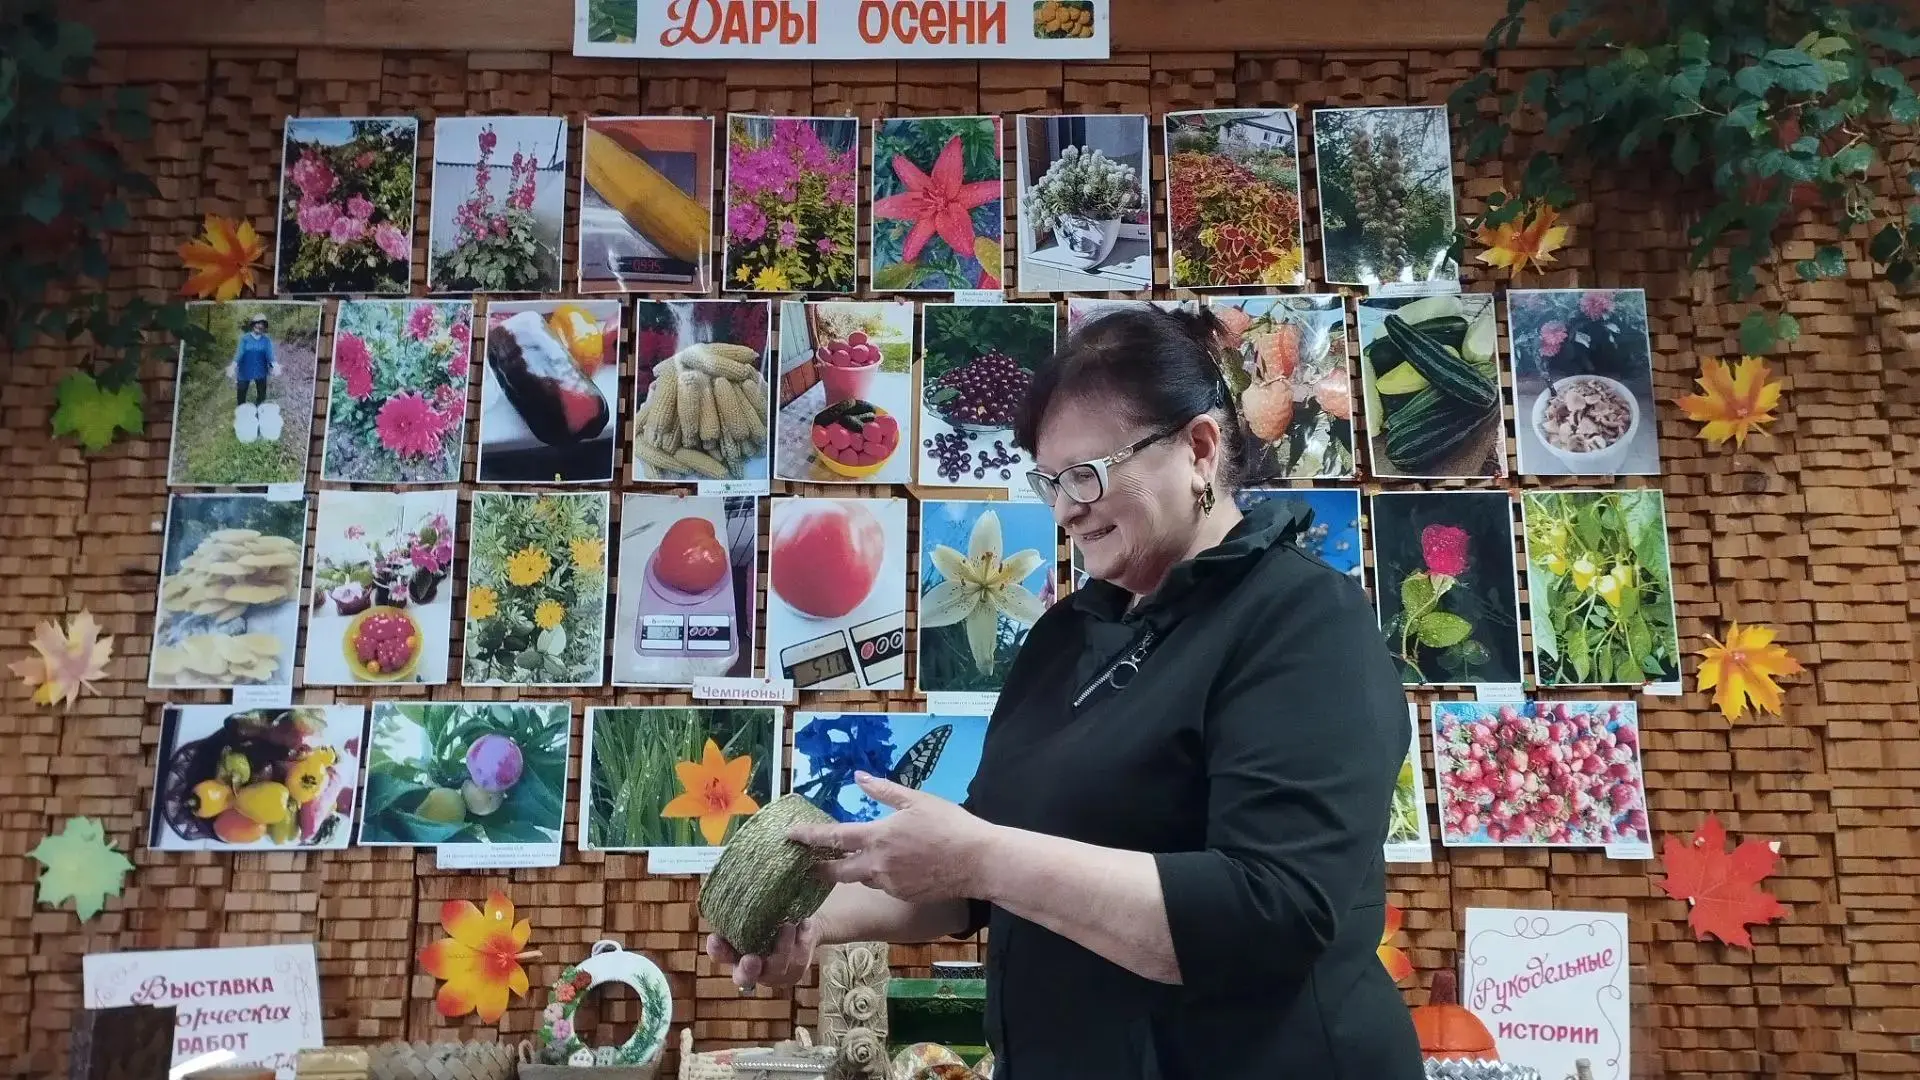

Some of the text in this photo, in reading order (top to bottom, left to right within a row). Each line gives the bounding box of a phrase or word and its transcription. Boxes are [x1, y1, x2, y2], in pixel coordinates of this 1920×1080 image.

[701, 685, 786, 700] Чемпионы!
[1473, 948, 1615, 1015] Рукодельные
[175, 1003, 291, 1032] орческих
[177, 1032, 250, 1056] РАБОТ
